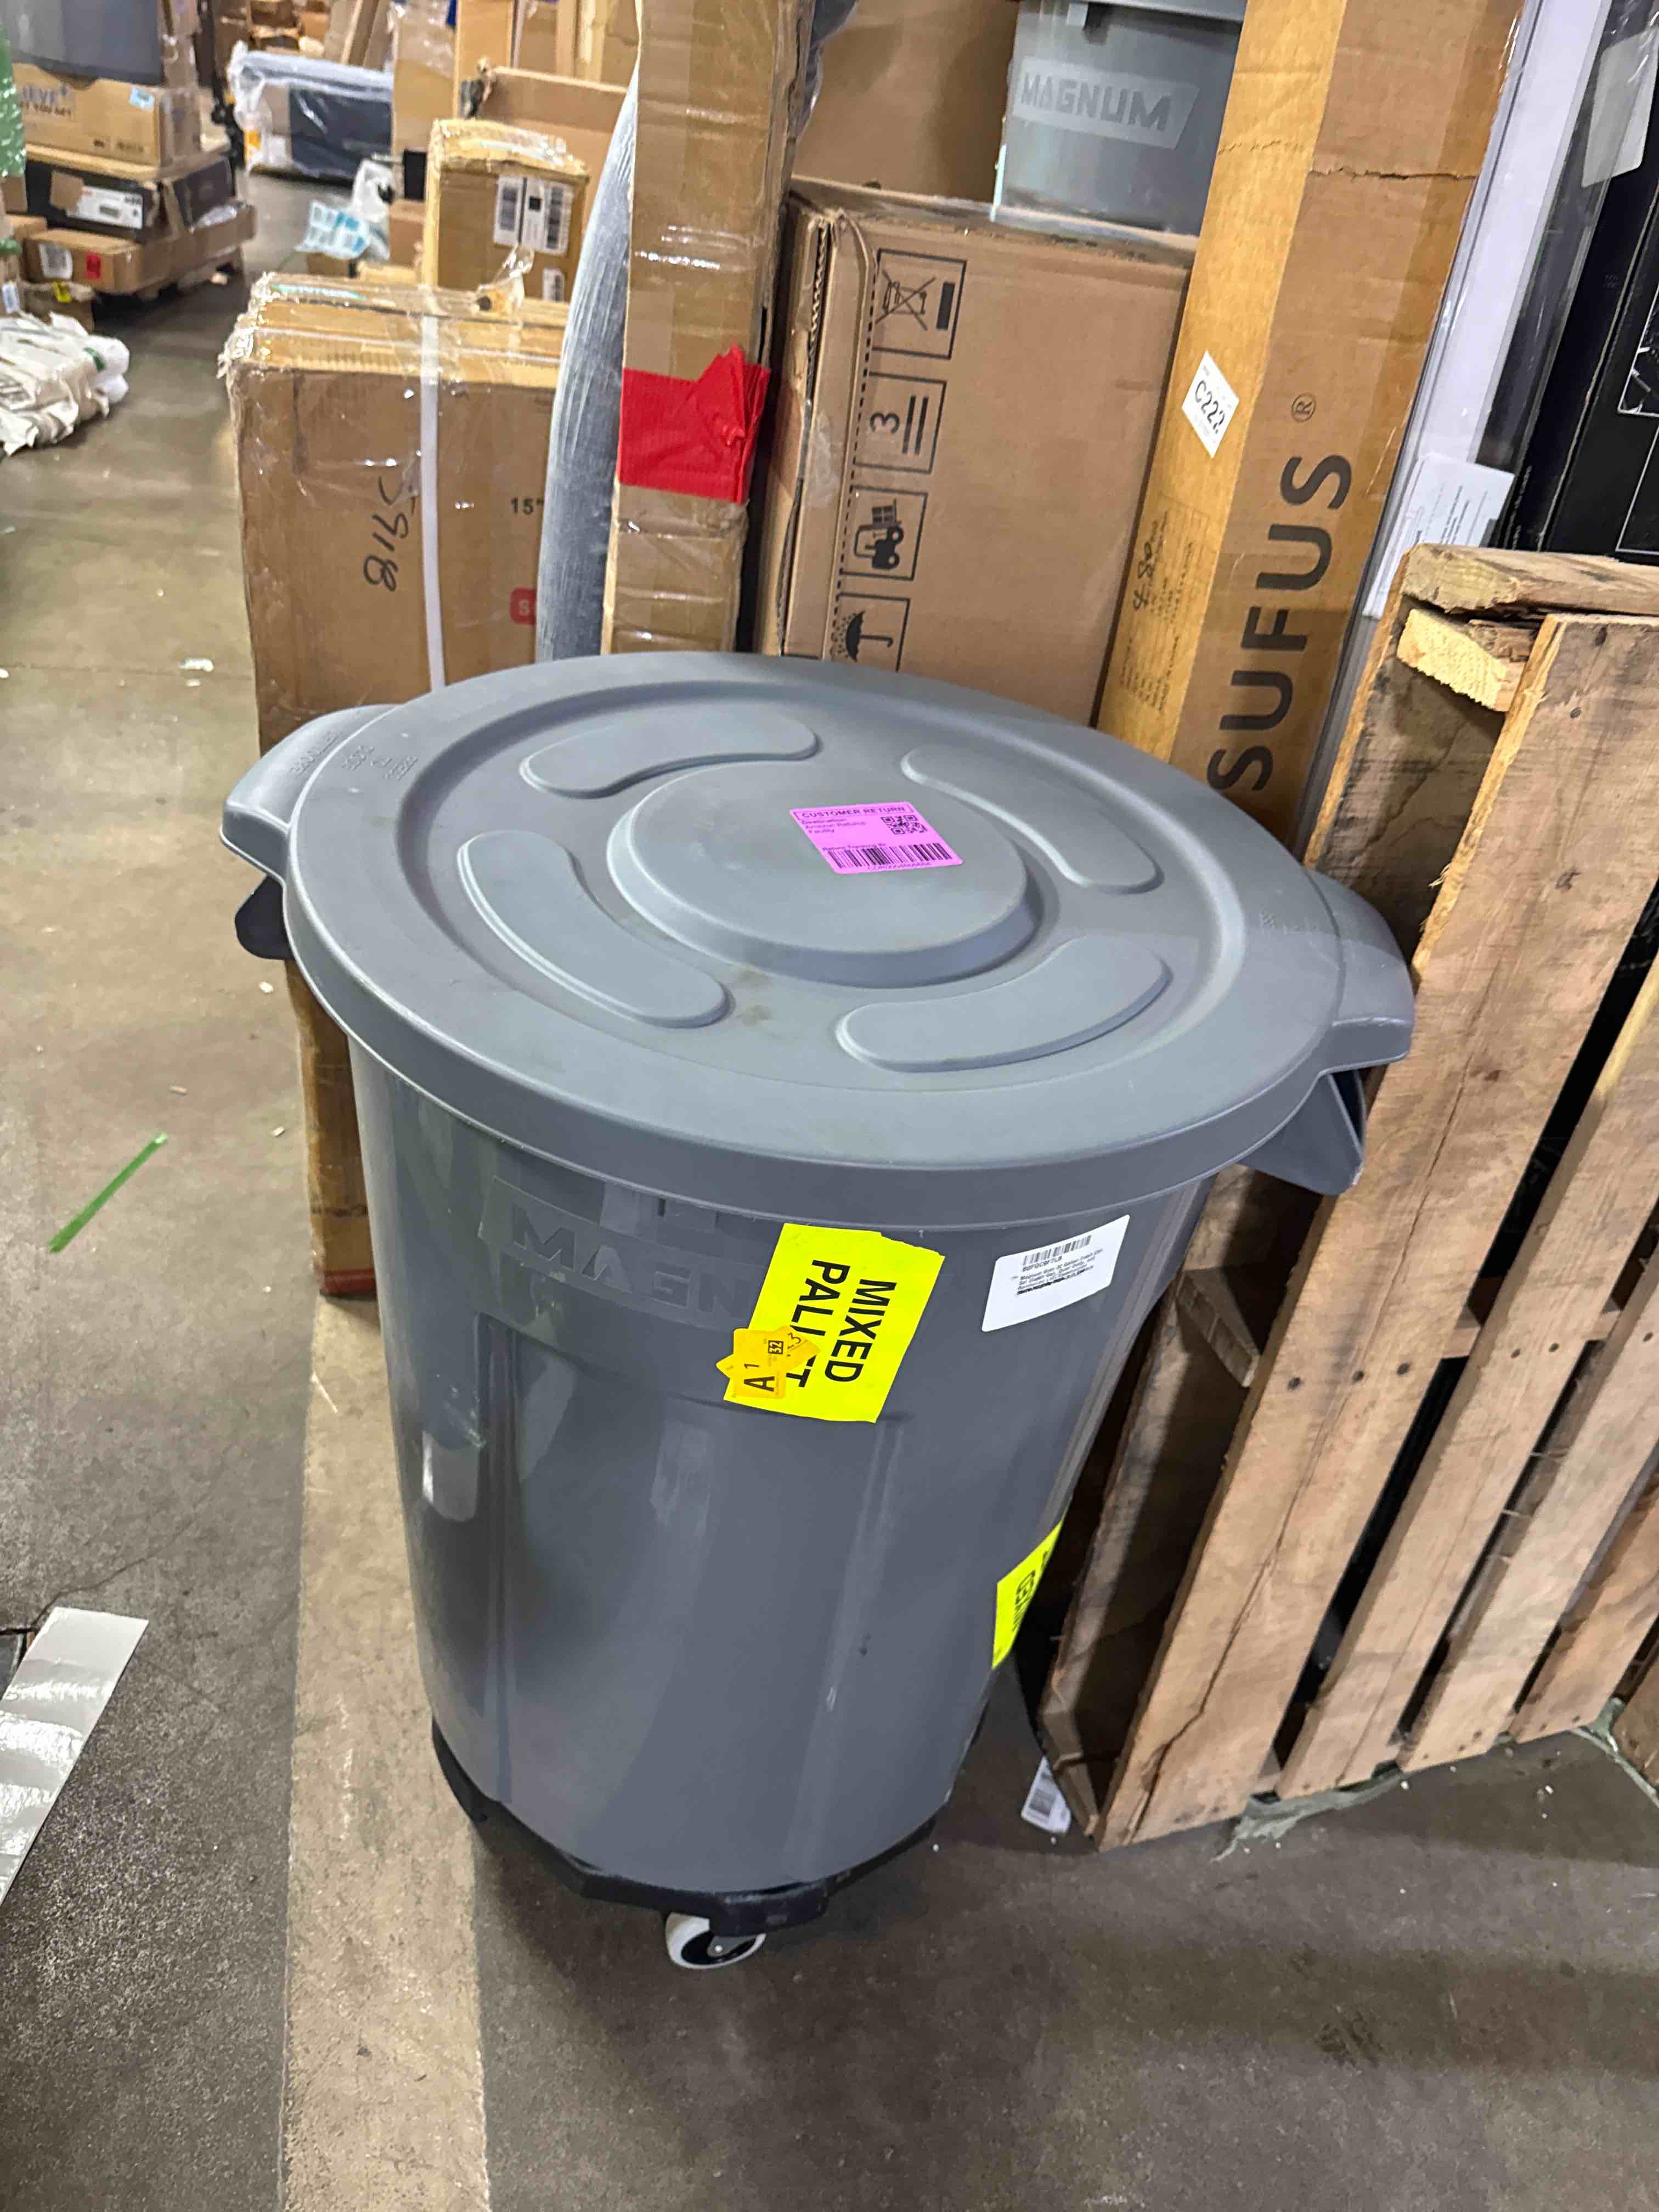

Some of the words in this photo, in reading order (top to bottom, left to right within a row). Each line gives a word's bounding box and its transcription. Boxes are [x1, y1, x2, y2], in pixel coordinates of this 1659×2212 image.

[1020, 71, 1172, 132] MAGNUM
[870, 412, 900, 433] 3
[1208, 454, 1352, 791] SUFUS
[802, 809, 861, 818] CUSTOMER
[769, 1341, 783, 1354] 32
[825, 1279, 897, 1382] MIXED
